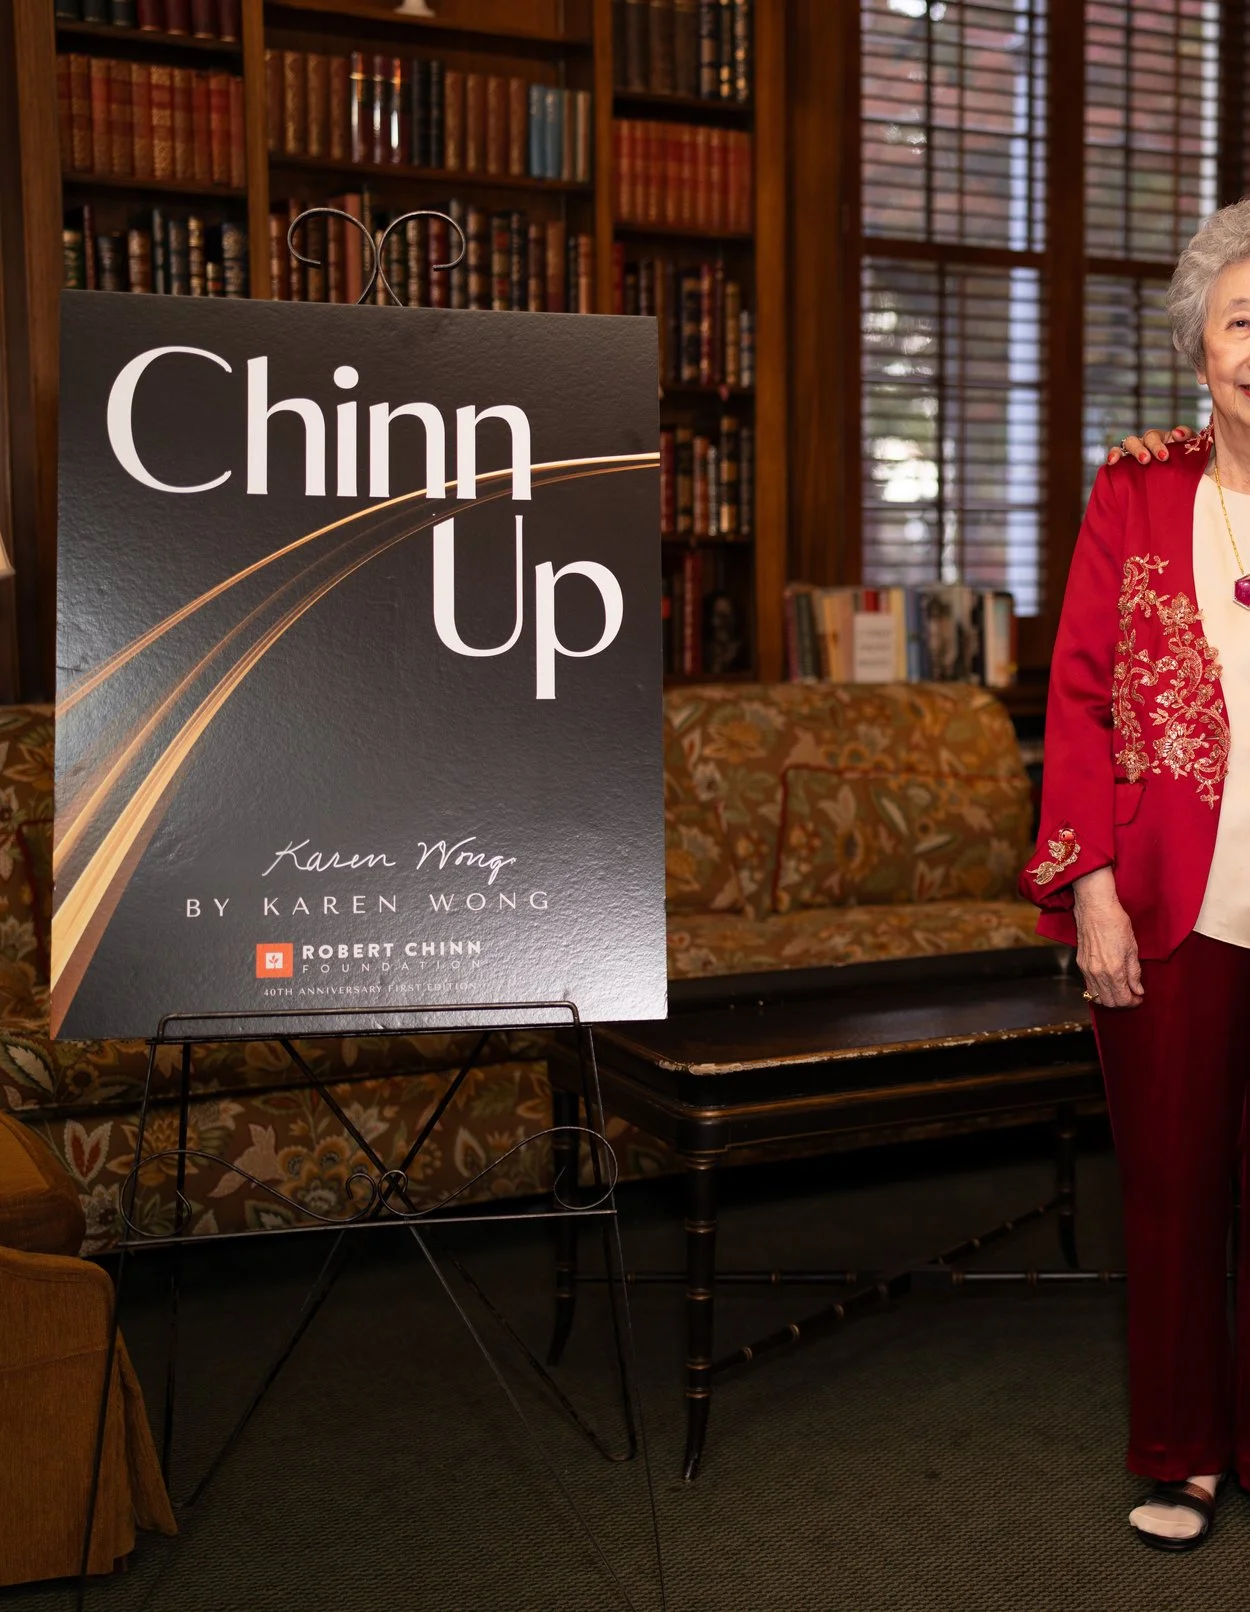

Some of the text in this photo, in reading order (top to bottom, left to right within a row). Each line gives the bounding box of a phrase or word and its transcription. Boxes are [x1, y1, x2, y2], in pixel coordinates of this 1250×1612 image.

[106, 345, 532, 500] Chinn
[433, 515, 624, 700] Up
[262, 836, 517, 886] Karen Wong
[186, 891, 549, 918] BY KAREN WONG
[302, 941, 482, 960] ROBERT CHINN
[302, 960, 482, 974] FOUNDATION
[263, 982, 478, 997] 40TH ANNIVERSARY FIRST EDITION
